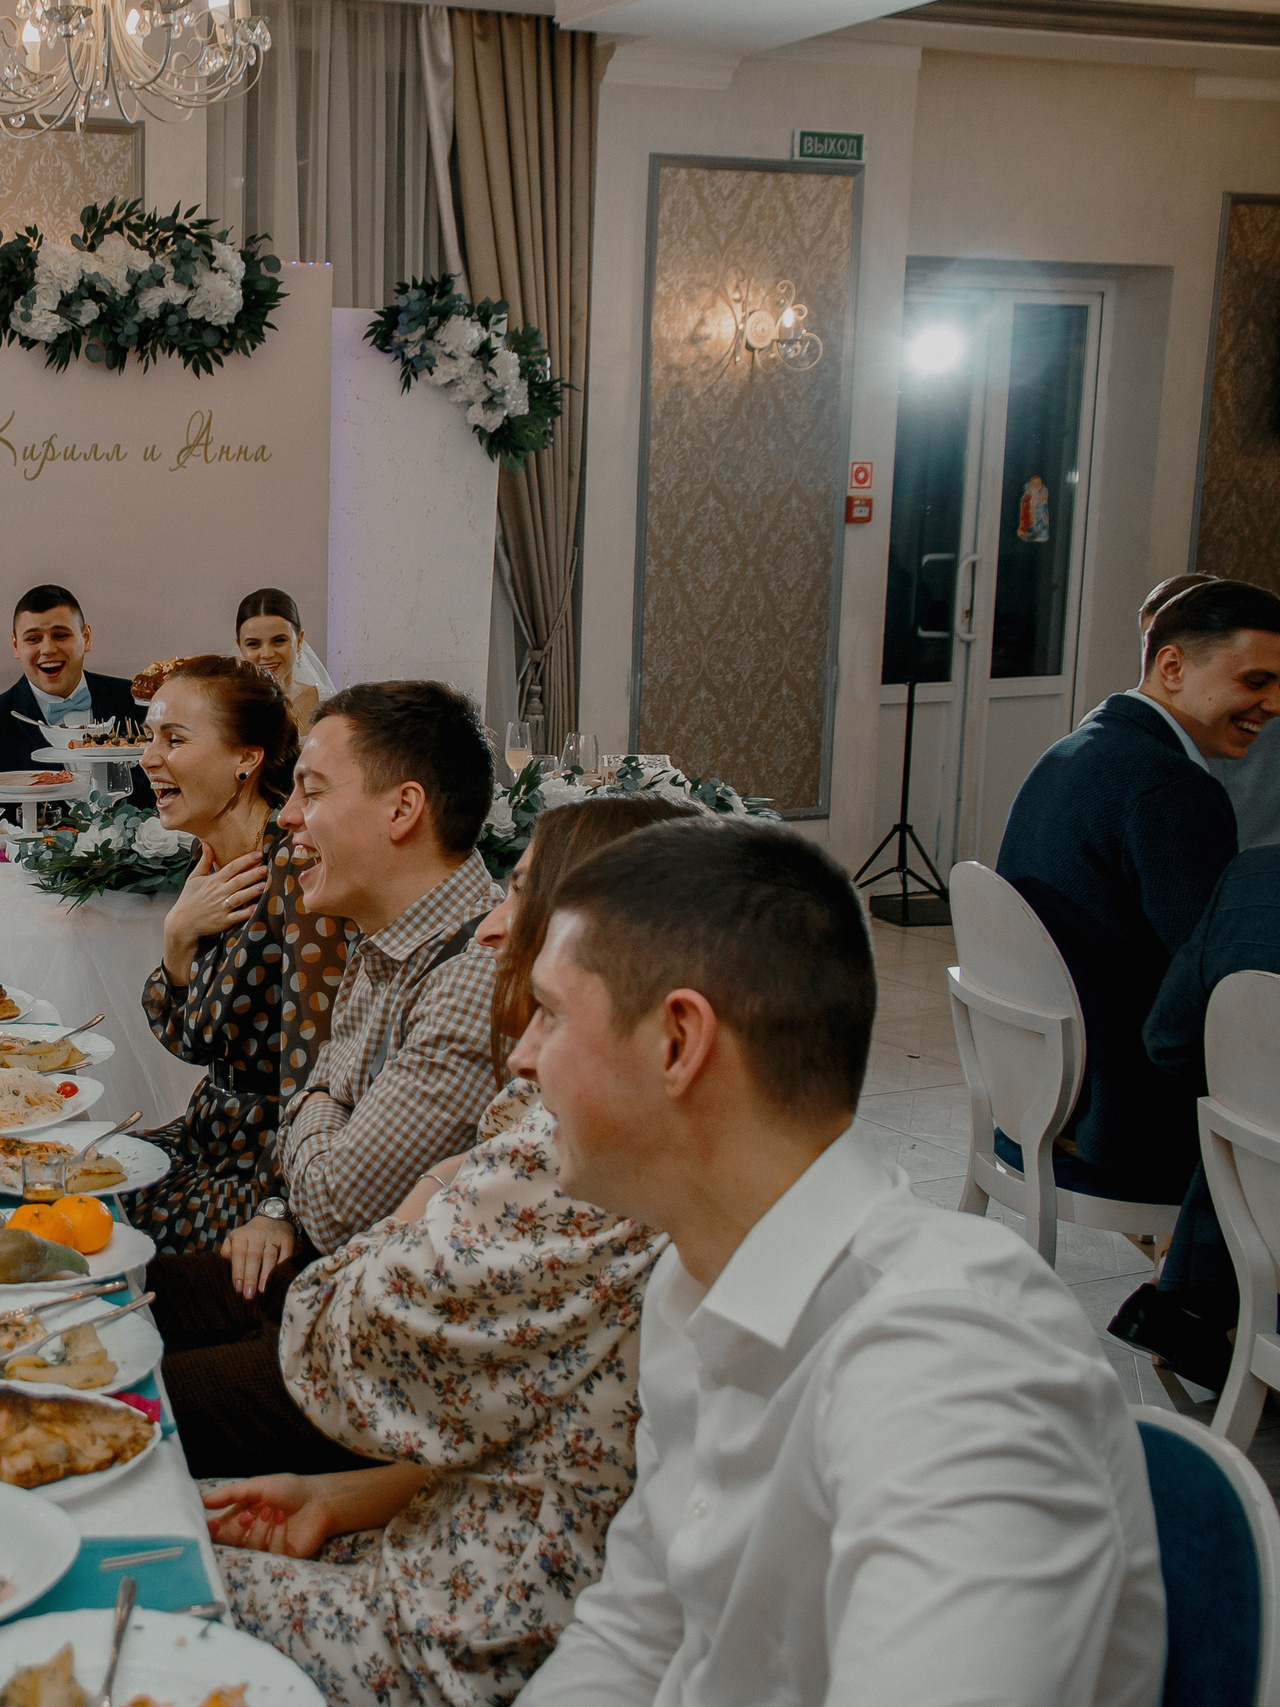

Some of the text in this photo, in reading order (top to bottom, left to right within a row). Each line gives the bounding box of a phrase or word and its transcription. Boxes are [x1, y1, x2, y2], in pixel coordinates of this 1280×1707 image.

[803, 136, 857, 157] ВЫХОД
[143, 444, 162, 463] и
[169, 409, 272, 472] Анна
